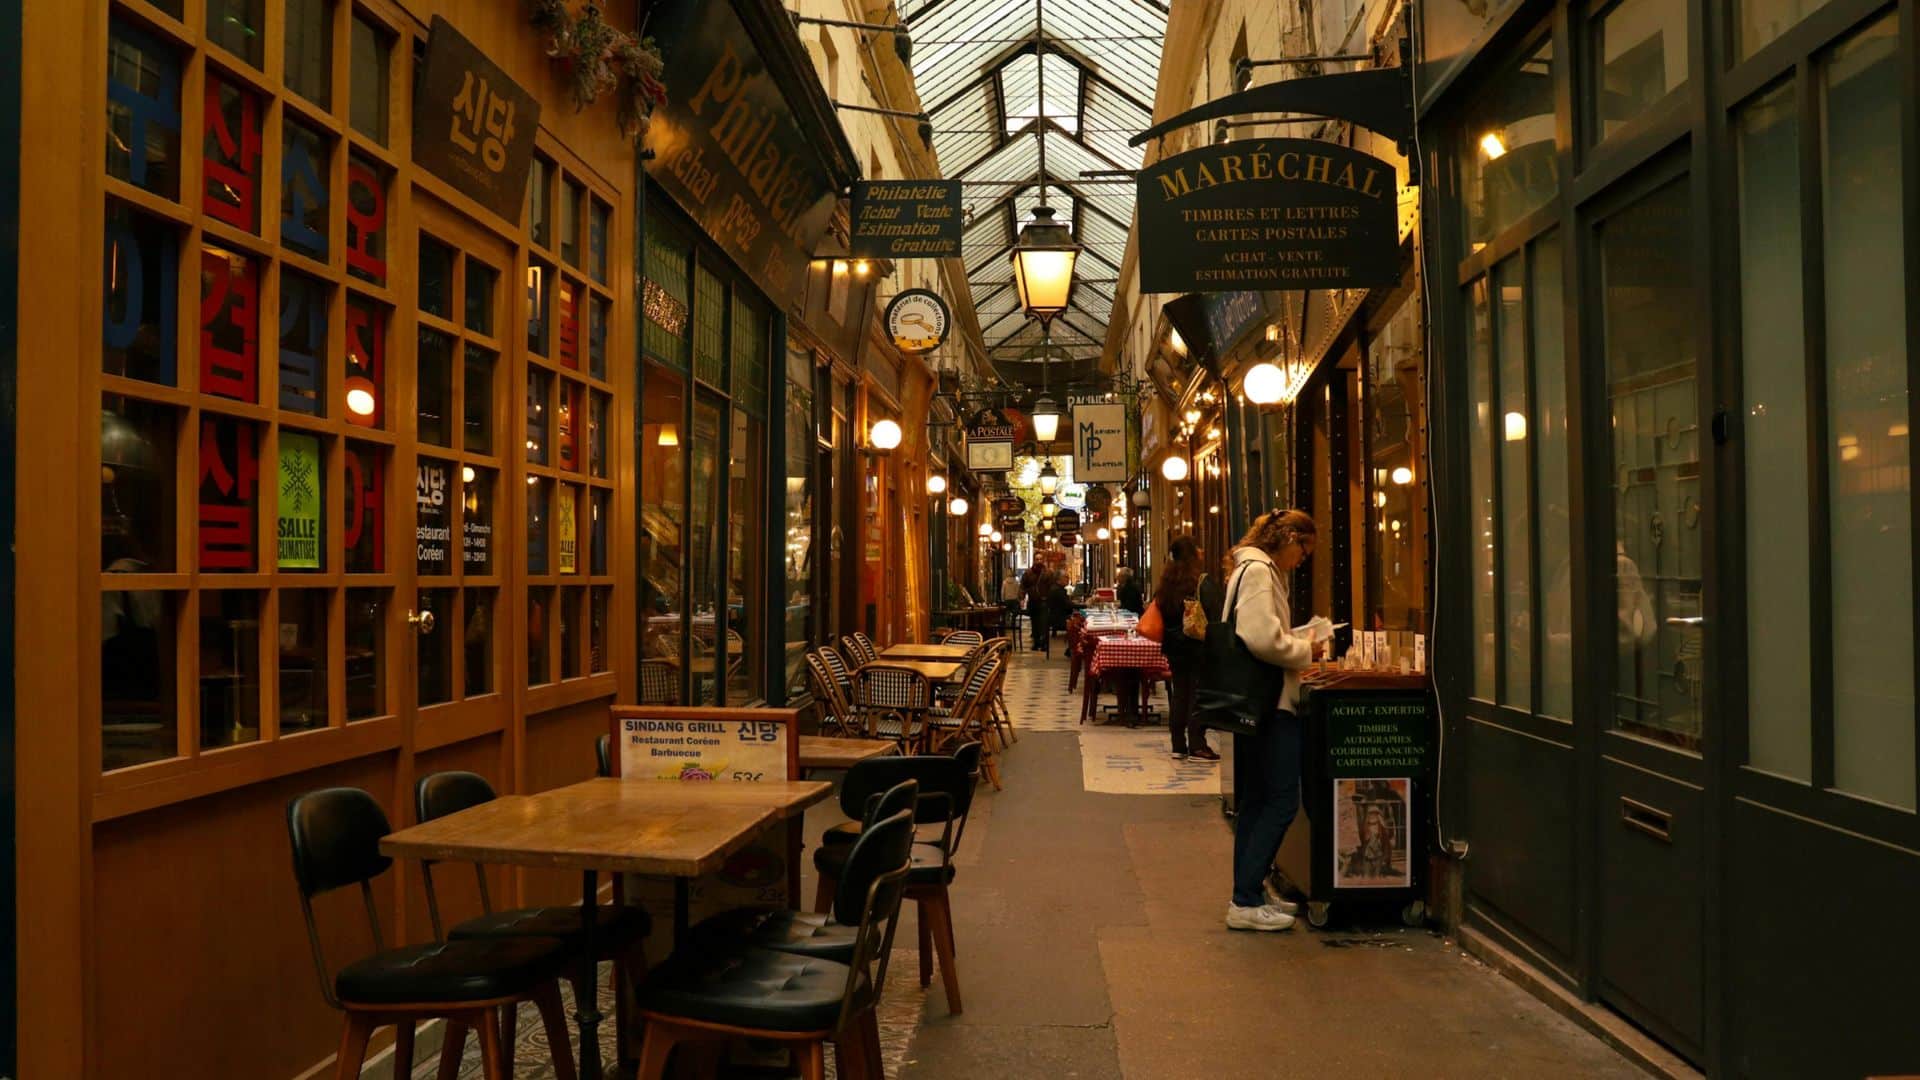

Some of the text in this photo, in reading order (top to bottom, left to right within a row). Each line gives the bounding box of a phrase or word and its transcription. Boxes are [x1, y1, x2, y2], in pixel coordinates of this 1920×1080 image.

[451, 69, 515, 173] 신당
[1156, 144, 1383, 201] MARÉCHAL
[860, 205, 953, 219] Achat Vente
[1181, 206, 1360, 222] TIMBRES ET LETTRES
[856, 222, 941, 236] Estimation
[1196, 227, 1348, 241] CARTES POSTALES
[891, 239, 956, 252] Gratuite
[1223, 252, 1266, 263] ACHAT
[1279, 251, 1323, 262] VENTE
[1195, 267, 1350, 281] ESTIMATION GRATUITE
[201, 66, 263, 570] 삼겹살
[277, 517, 315, 538] SALLE
[1332, 706, 1367, 716] ACHAT
[625, 720, 726, 734] SINDANG GRILL
[737, 720, 780, 743] 신당
[1356, 724, 1399, 733] TIMBRES
[631, 735, 683, 746] Restaurant
[1343, 736, 1413, 745] AUTOGRAPHES
[1329, 746, 1425, 756] COURRIERS ANCIENS
[1336, 757, 1420, 768] CARTES POSTALES
